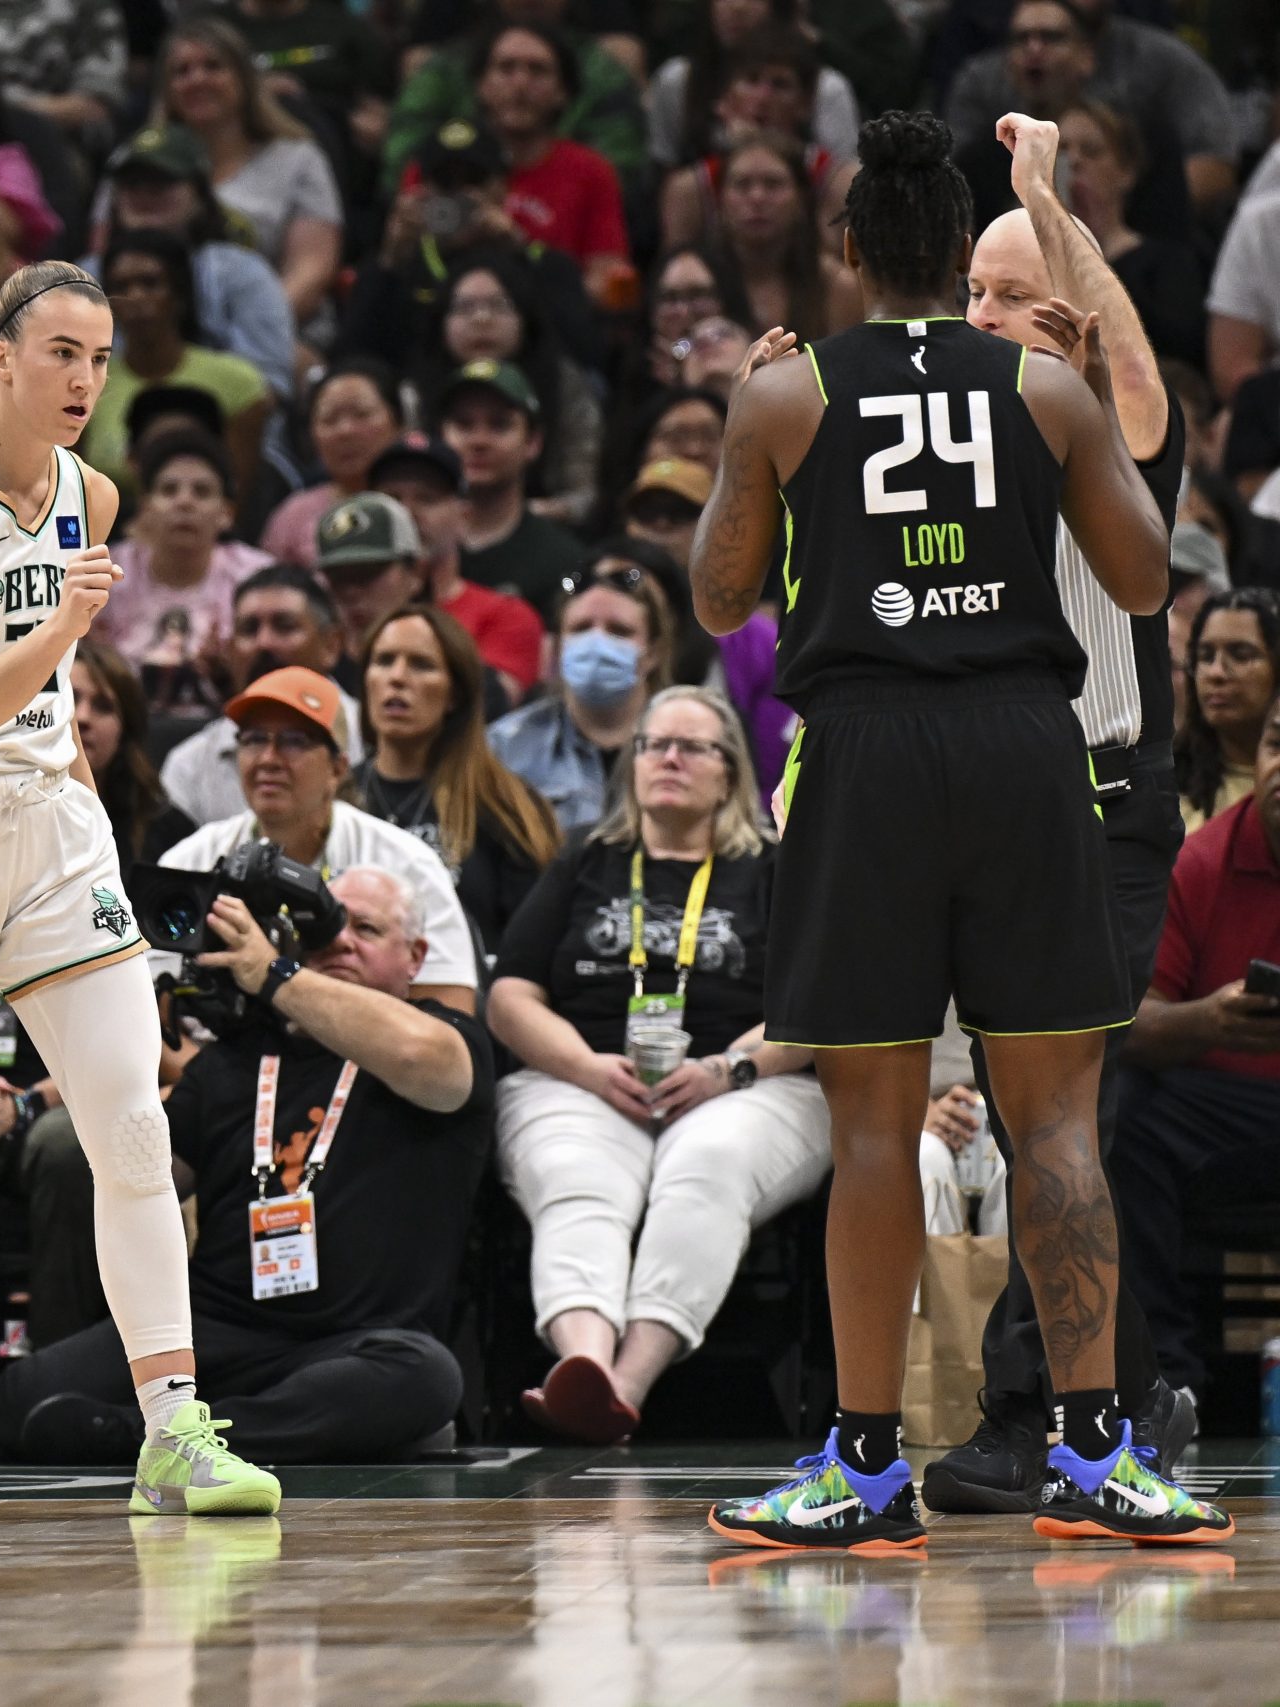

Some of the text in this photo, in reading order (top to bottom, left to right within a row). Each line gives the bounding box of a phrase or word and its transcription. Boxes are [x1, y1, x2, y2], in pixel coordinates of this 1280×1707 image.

[858, 390, 997, 515] 24
[902, 522, 965, 567] LOYD
[921, 581, 1006, 618] AT&T
